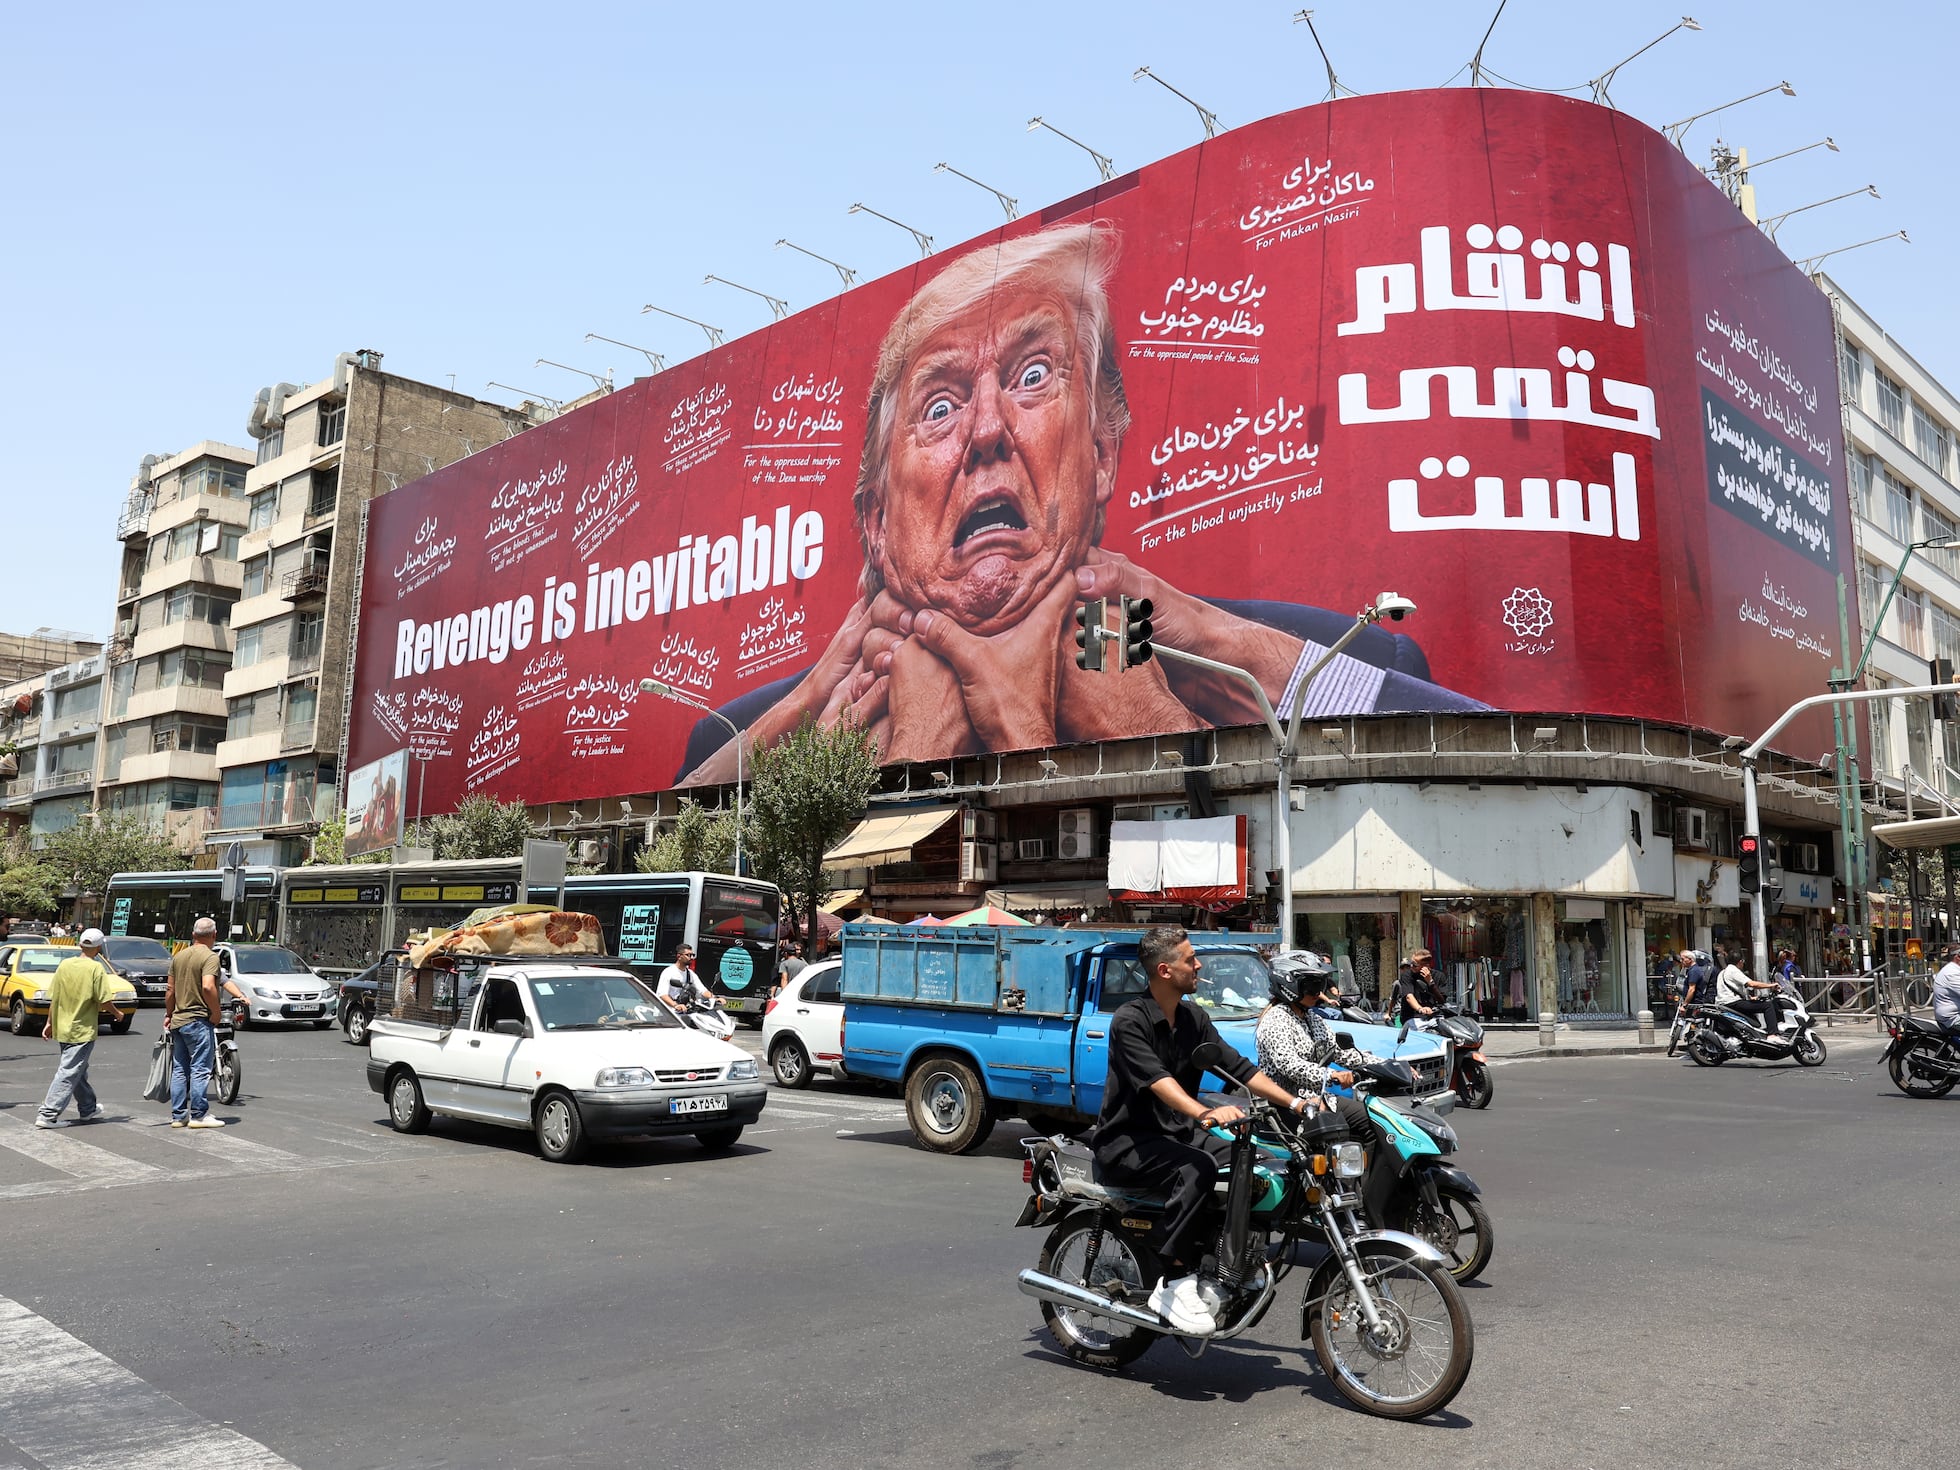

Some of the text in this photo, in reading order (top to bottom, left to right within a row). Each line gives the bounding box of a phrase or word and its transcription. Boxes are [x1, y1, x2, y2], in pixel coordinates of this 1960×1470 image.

[1282, 158, 1332, 190] برای
[1240, 171, 1375, 230] ماکان نصیری
[1256, 206, 1360, 250] For Makan Nasiri
[1166, 274, 1266, 308] برای مردم
[1337, 223, 1635, 336] انتقام
[1140, 306, 1264, 340] مظلوم جنوب
[1128, 346, 1260, 365] For the oppressed people of the South
[1705, 310, 1817, 413] این جنایتکاران که فهرستی
[671, 383, 726, 419] برای آنها که
[772, 372, 844, 404] برای شهدای
[1338, 346, 1661, 440] حتمی
[664, 399, 732, 443] در محل کارشان
[754, 406, 843, 440] مظلوم ناو دنا
[1254, 396, 1305, 436] برای
[670, 418, 722, 454] شهید شدند
[548, 460, 567, 486] برای
[744, 454, 840, 470] For the oppressed martyrs
[752, 471, 826, 485] of the Dena warship
[491, 482, 510, 509] که
[576, 455, 632, 514] برای آنان که
[1388, 451, 1640, 541] است
[572, 470, 637, 542] زیر آوار ماندند
[1141, 478, 1322, 552] For the blood unjustly shed
[415, 517, 438, 544] برای
[394, 551, 422, 581] میناب
[394, 504, 824, 679] Revenge is inevitable
[759, 596, 784, 618] برای
[740, 604, 805, 646] زهرا کوچولو
[660, 632, 720, 672] برای مادران
[738, 630, 803, 661] چهارده ماهه
[524, 650, 564, 676] برای آنان که
[653, 658, 713, 690] داغدار ایران
[412, 686, 464, 714] برای دادخواهی
[566, 674, 618, 700] دادخواهی
[619, 679, 640, 704] برای
[483, 705, 504, 727] برای
[566, 704, 629, 728] خون رهبرم
[573, 734, 612, 746] For the justice
